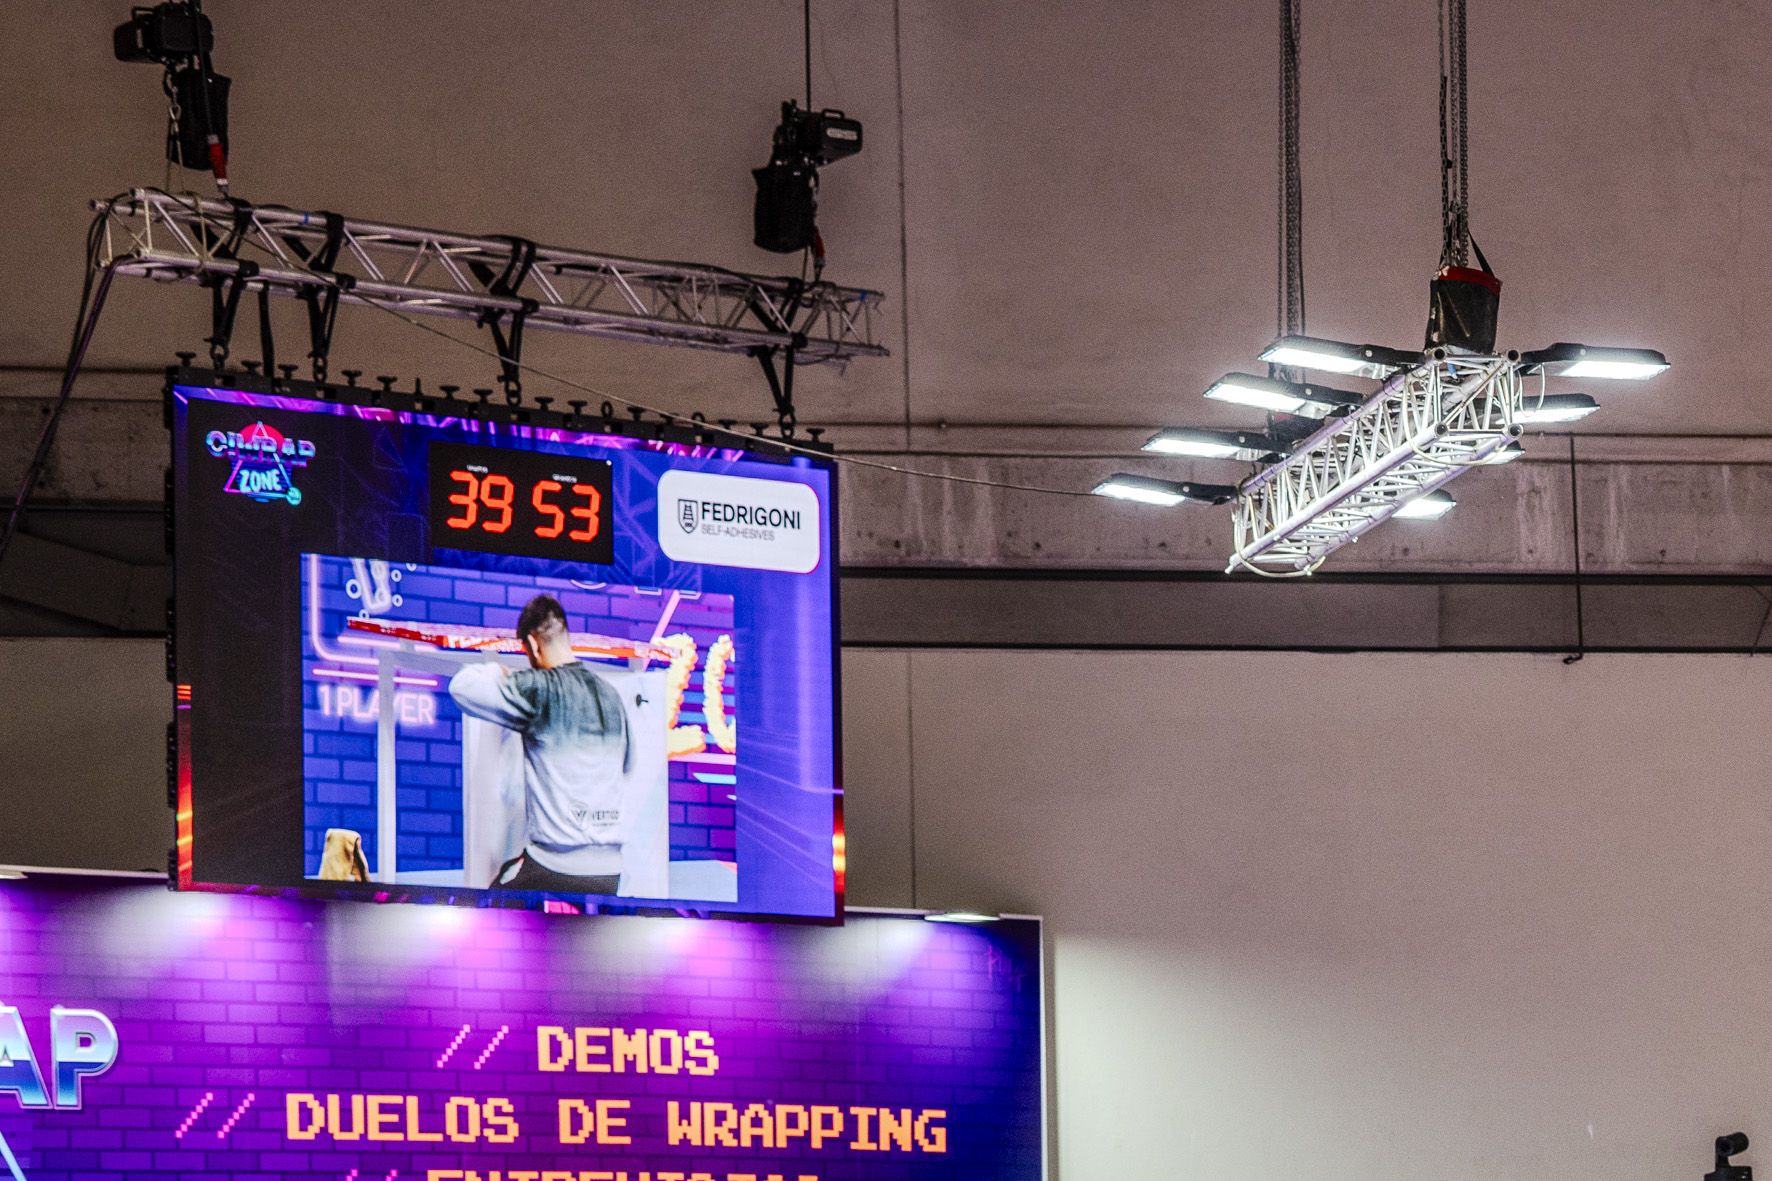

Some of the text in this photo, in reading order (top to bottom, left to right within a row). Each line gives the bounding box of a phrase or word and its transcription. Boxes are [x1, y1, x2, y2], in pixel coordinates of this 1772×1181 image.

[239, 468, 282, 493] ZONE
[446, 470, 601, 543] 39 53
[701, 501, 801, 530] FEDRIGONI
[701, 523, 775, 541] SELF-ADHESIVES
[337, 686, 436, 725] PLAER
[537, 1025, 719, 1076] DEMOS
[286, 1093, 519, 1143] DUELOS
[558, 1099, 632, 1145] DE
[667, 1101, 947, 1153] WRAPPING
